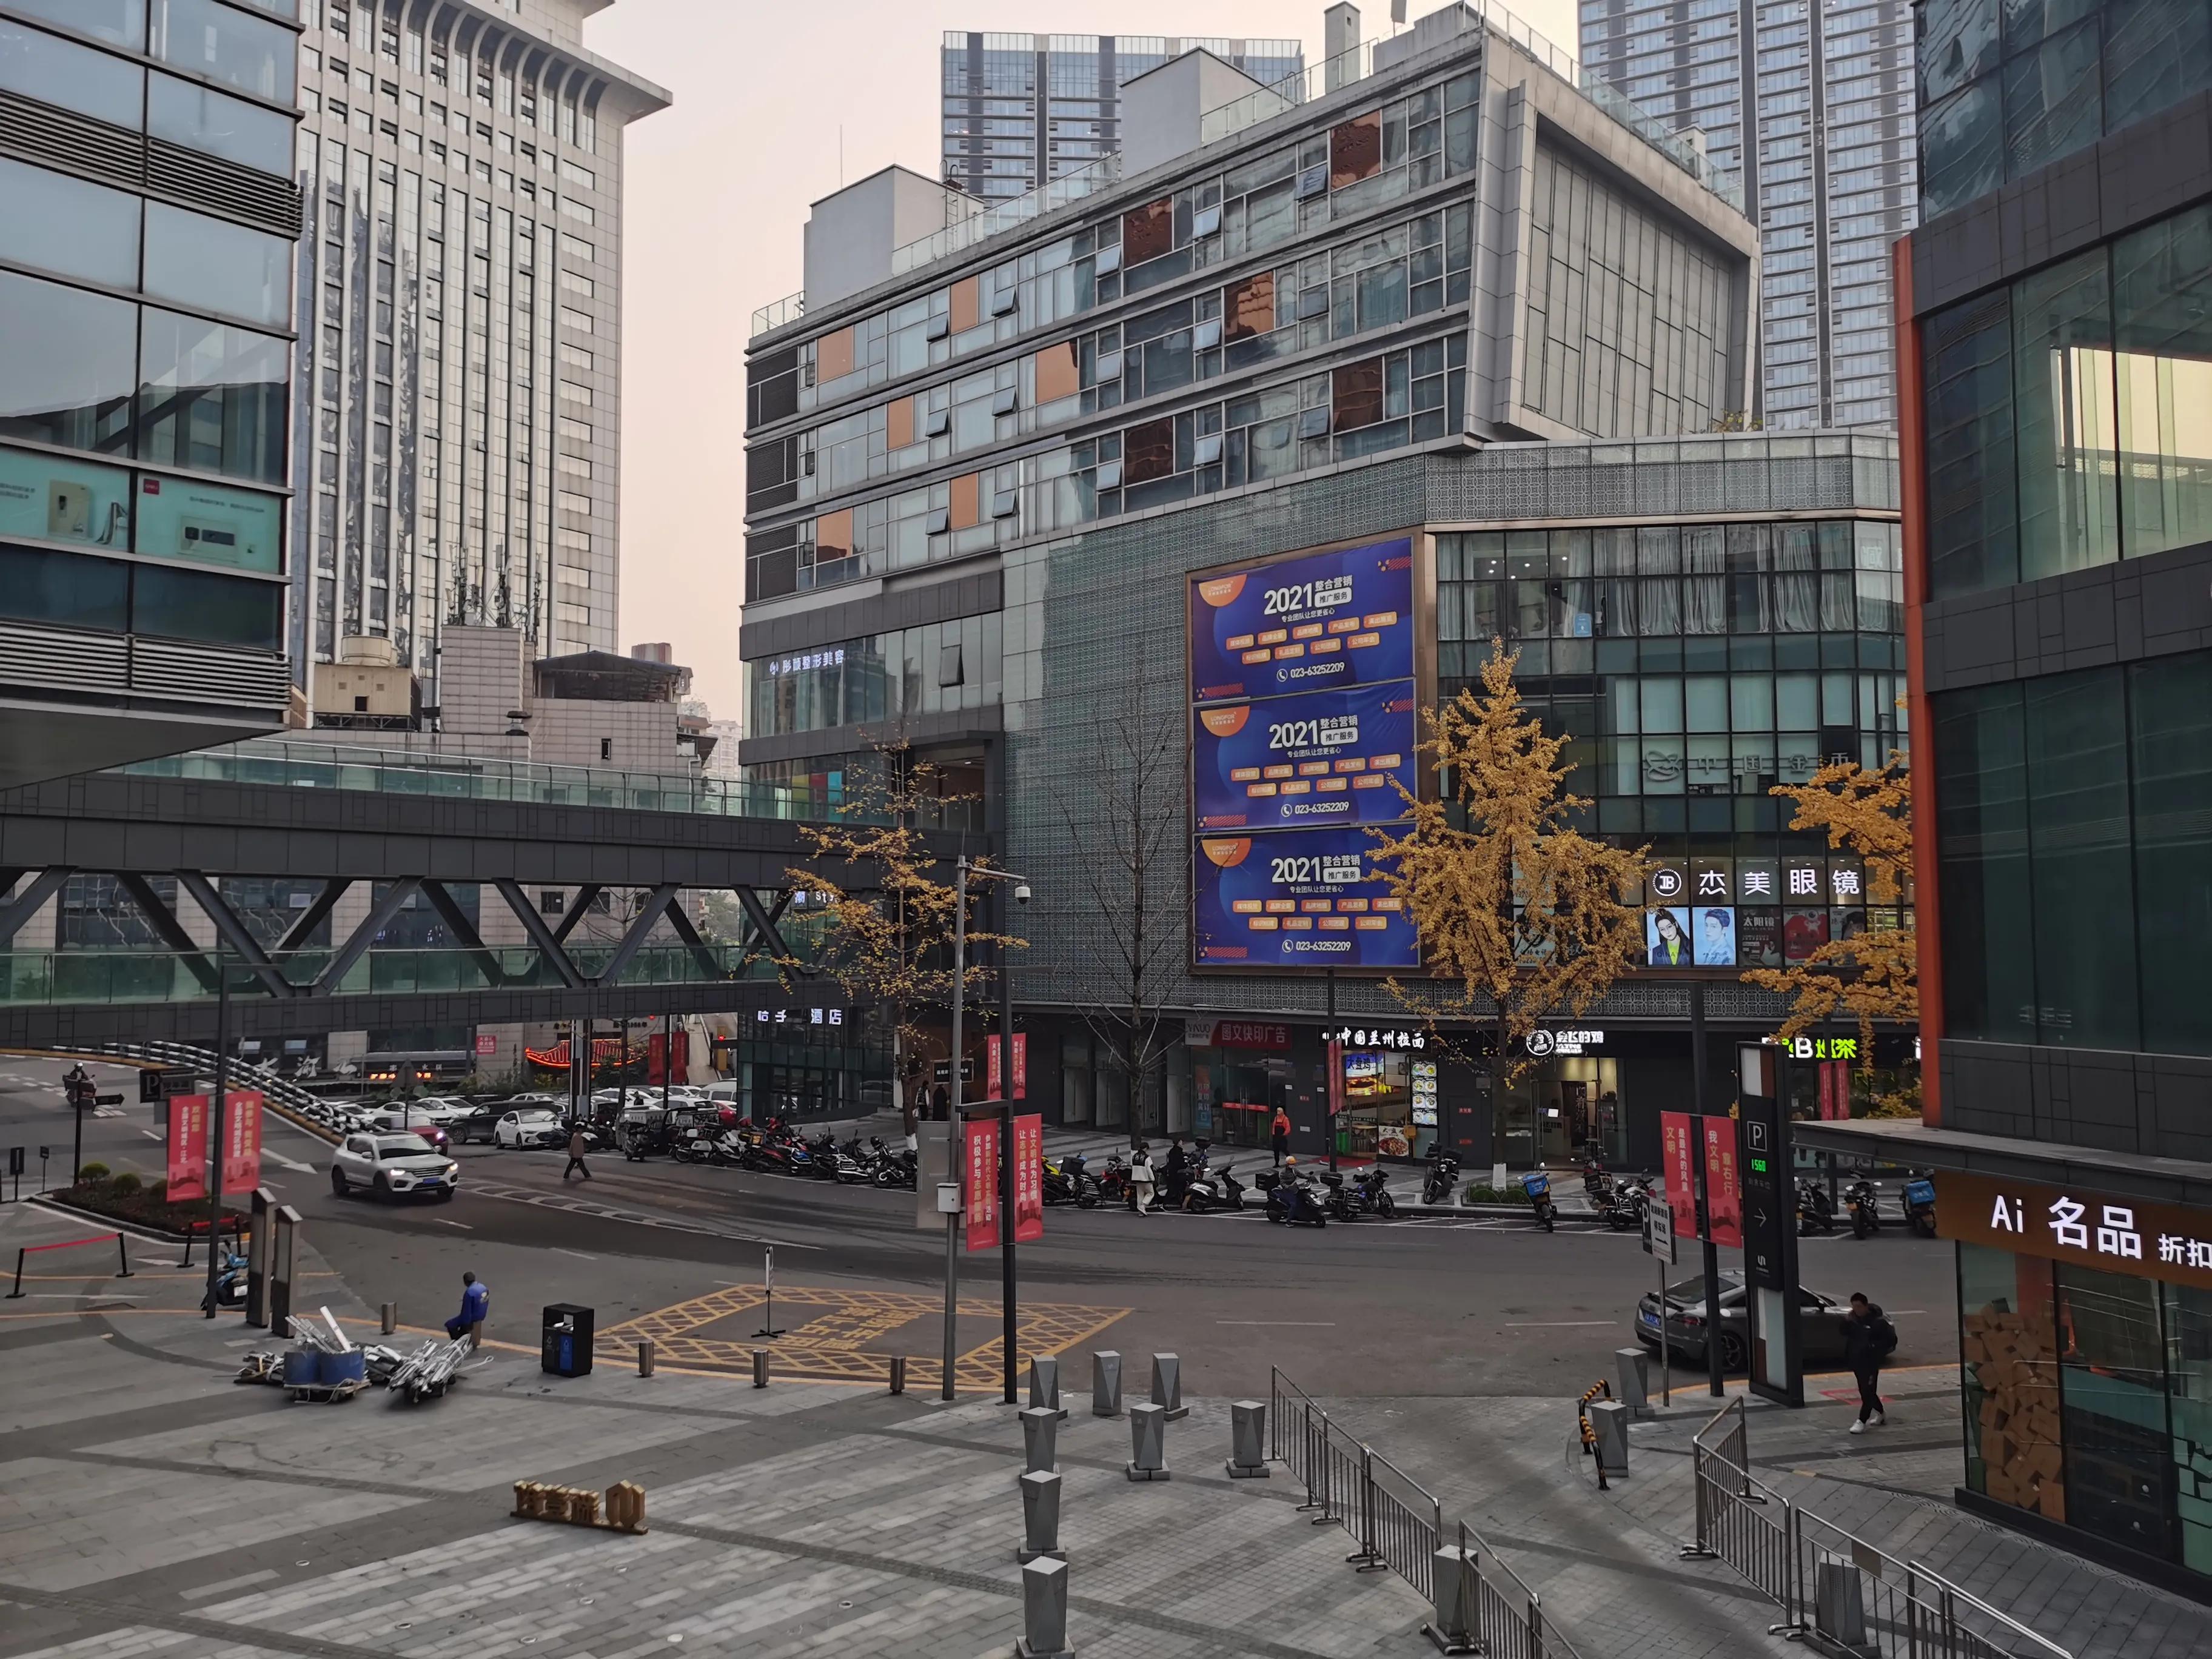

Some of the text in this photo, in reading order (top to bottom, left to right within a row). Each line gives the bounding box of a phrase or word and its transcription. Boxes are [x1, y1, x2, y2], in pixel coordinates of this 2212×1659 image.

[1315, 575, 1353, 592] 整合营销
[1264, 582, 1312, 615] 2021
[1319, 591, 1347, 604] 推广服务
[1281, 608, 1335, 623] 专业团队让您更省心
[1290, 662, 1345, 679] 023-63252209
[1320, 715, 1358, 729] 整合营销
[1269, 720, 1318, 749] 2021
[1326, 731, 1354, 742] 推广服务
[1287, 746, 1341, 757] 专业团队让您更省心
[1698, 752, 1849, 774] 中国金币
[1295, 802, 1349, 814] 023-63252209
[1322, 854, 1361, 866] 整合营销
[1271, 857, 1321, 883] 2021
[1328, 870, 1356, 880] 推广服务
[1699, 868, 1860, 896] 杰美眼镜
[1296, 941, 1351, 951] 023-63252209
[811, 1008, 842, 1025] 酒店
[1222, 1024, 1285, 1043] 图文快印广告
[1341, 1027, 1424, 1049] 中国兰州拉面
[1556, 1031, 1603, 1043] 会飞的鸡
[1347, 1057, 1371, 1071] 大盘鸡
[1666, 1127, 1675, 1154] 文明
[1753, 1125, 1762, 1146] P
[1678, 1128, 1688, 1192] 是最美的风景
[1708, 1130, 1720, 1173] 我文明
[1722, 1152, 1732, 1195] 靠右行
[1751, 1159, 1766, 1171] 1560
[1642, 1202, 1649, 1233] P
[1991, 1195, 2212, 1270] Ai 名品 折扣
